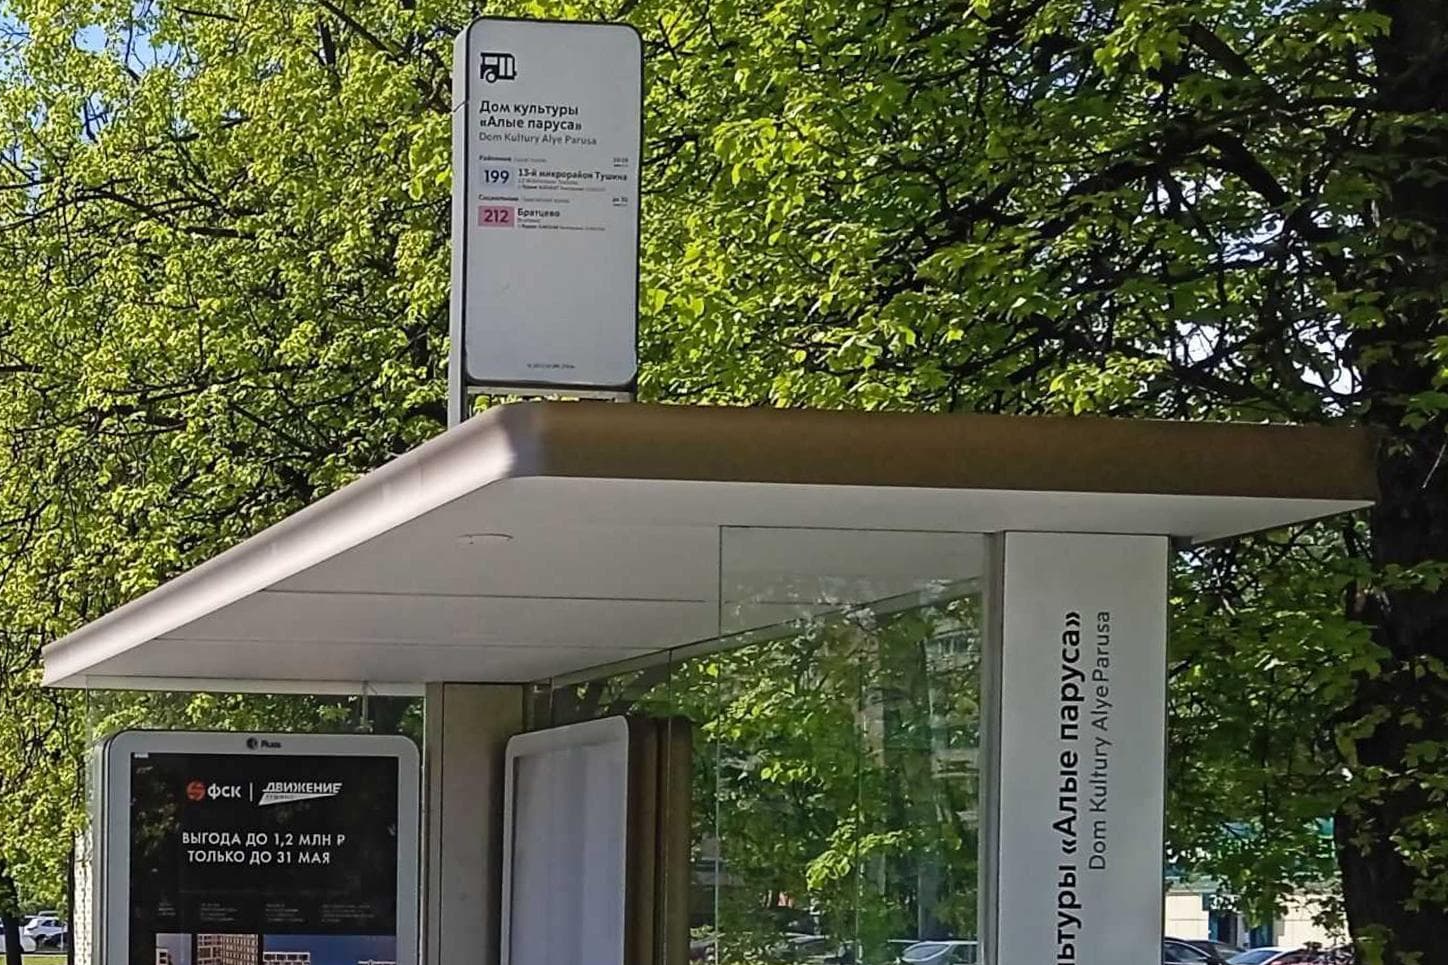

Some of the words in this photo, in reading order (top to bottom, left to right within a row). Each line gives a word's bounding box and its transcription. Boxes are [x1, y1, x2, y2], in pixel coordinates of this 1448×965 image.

[479, 100, 510, 114] Дом
[514, 104, 579, 117] культуры
[480, 116, 524, 128] «Алые
[528, 119, 582, 132] паруса»
[479, 132, 502, 141] Dom
[504, 133, 539, 144] Kultury
[542, 135, 563, 145] Alye
[565, 135, 597, 145] Parusa
[484, 169, 509, 184] 199
[483, 209, 509, 223] 212
[517, 208, 560, 218] Братцево
[1092, 611, 1111, 682] Parusa
[1059, 611, 1085, 741] паруса»
[1091, 686, 1112, 731] Alye
[1090, 737, 1113, 814] Kultury
[262, 782, 343, 794] ДВИЖЕНИЕ
[1052, 751, 1079, 855] «Алые
[182, 833, 241, 846] ВЫГОДА
[246, 833, 268, 847] ДО
[274, 834, 294, 847] 1,2
[299, 834, 332, 846] МЛН
[1089, 823, 1107, 870] Dom
[188, 850, 245, 863] ТОЛЬКО
[249, 851, 272, 865] ДО
[277, 852, 292, 864] 31
[298, 853, 330, 864] МАЯ
